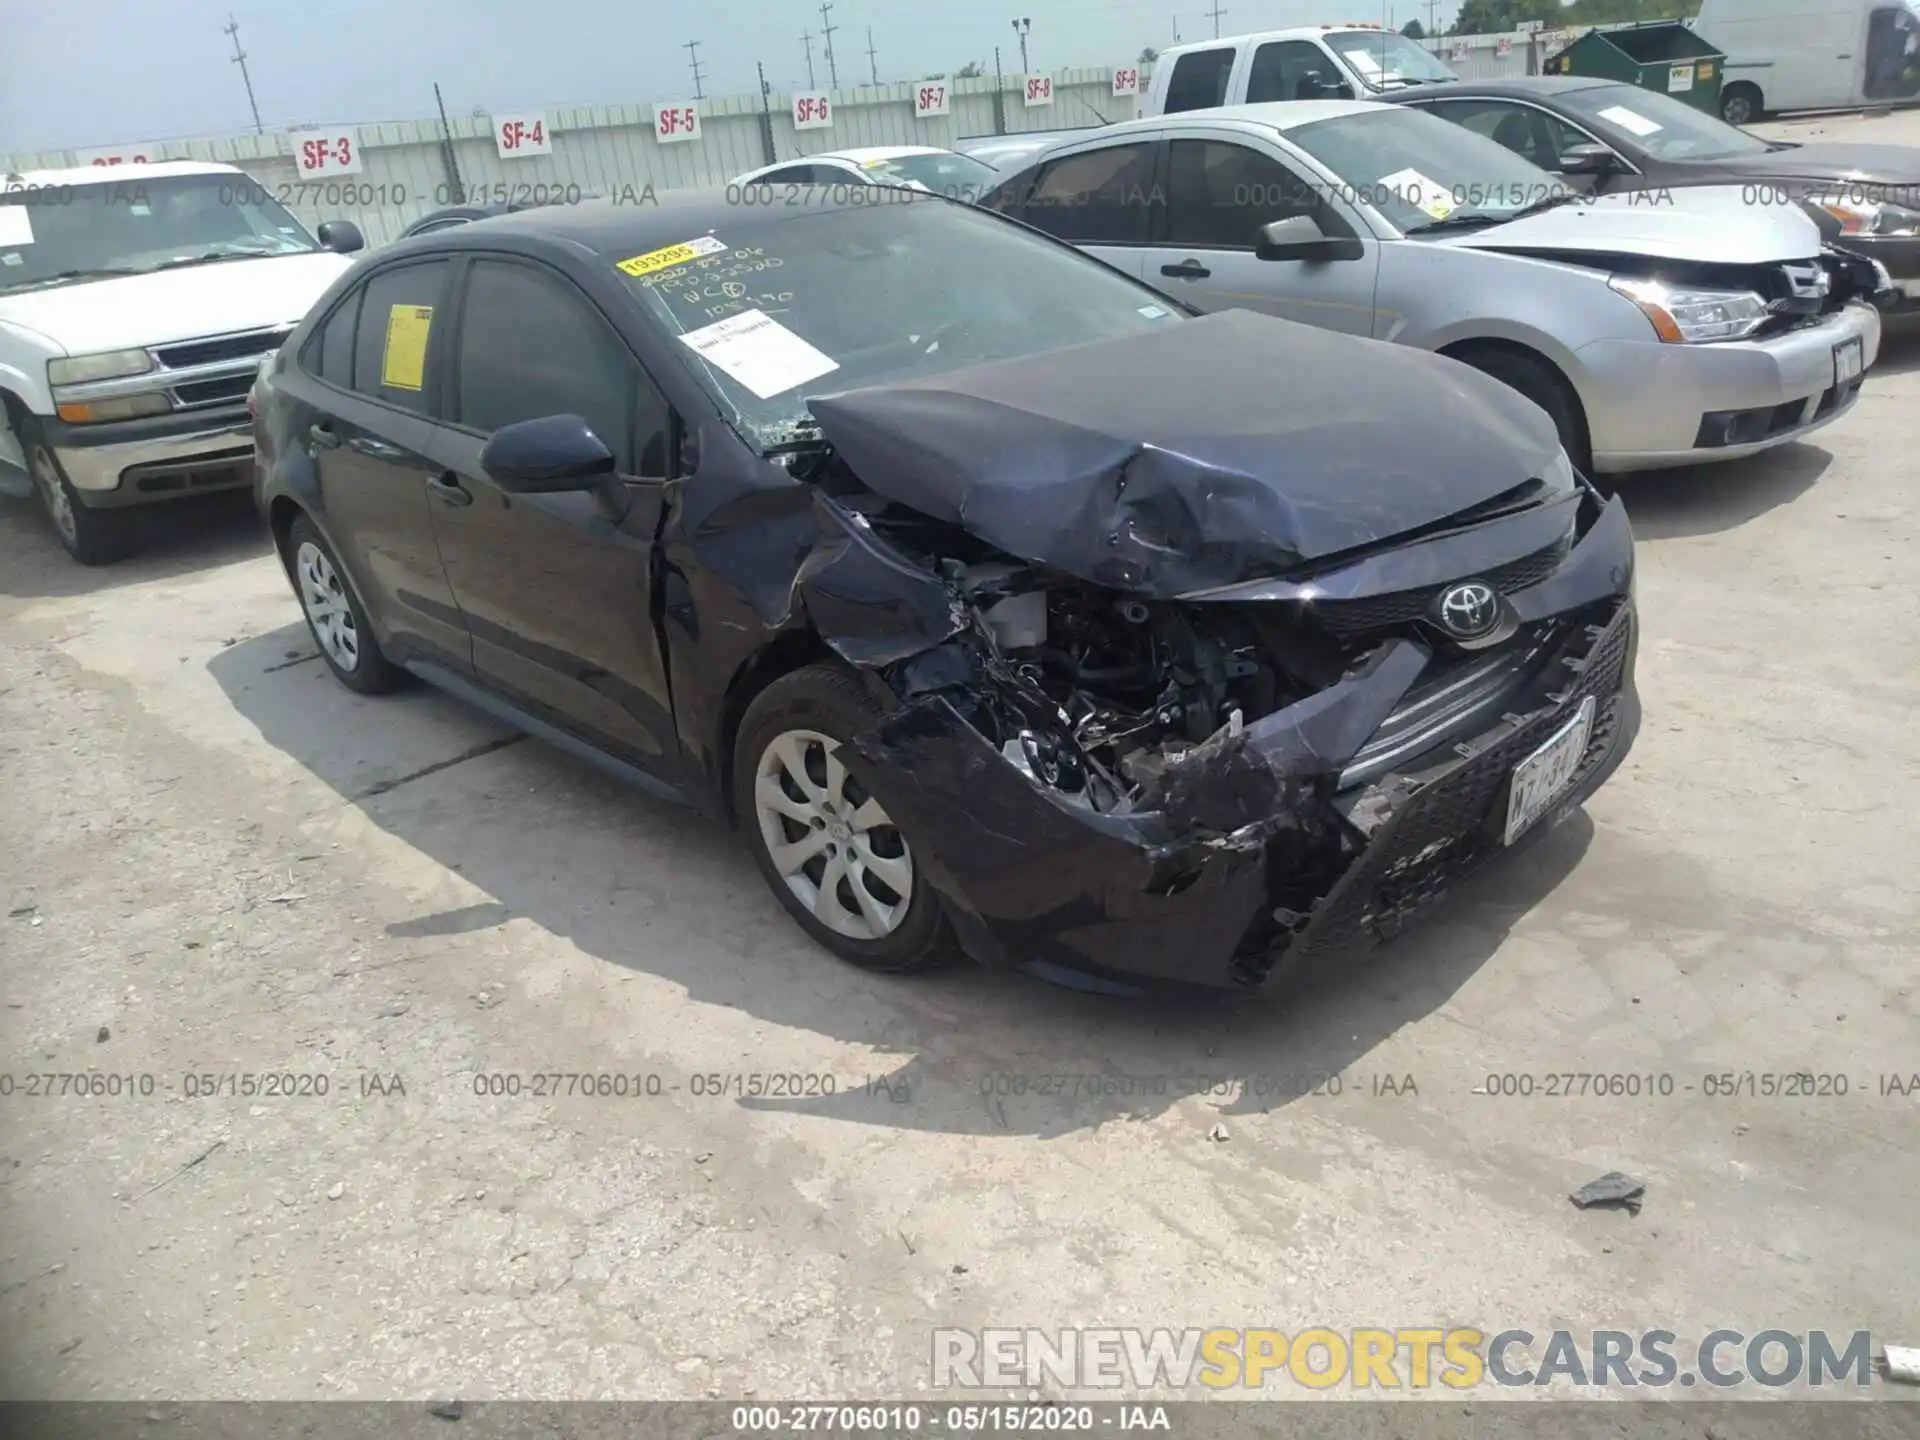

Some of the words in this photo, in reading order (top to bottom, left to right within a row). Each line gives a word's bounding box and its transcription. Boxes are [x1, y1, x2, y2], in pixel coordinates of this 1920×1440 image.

[1027, 78, 1050, 99] SF-8
[1116, 69, 1136, 89] SF-9
[797, 97, 828, 122] SF-6
[919, 87, 944, 110] SF-7
[660, 107, 695, 136] SF-5
[502, 120, 544, 150] SF-4
[303, 137, 350, 169] SF-3
